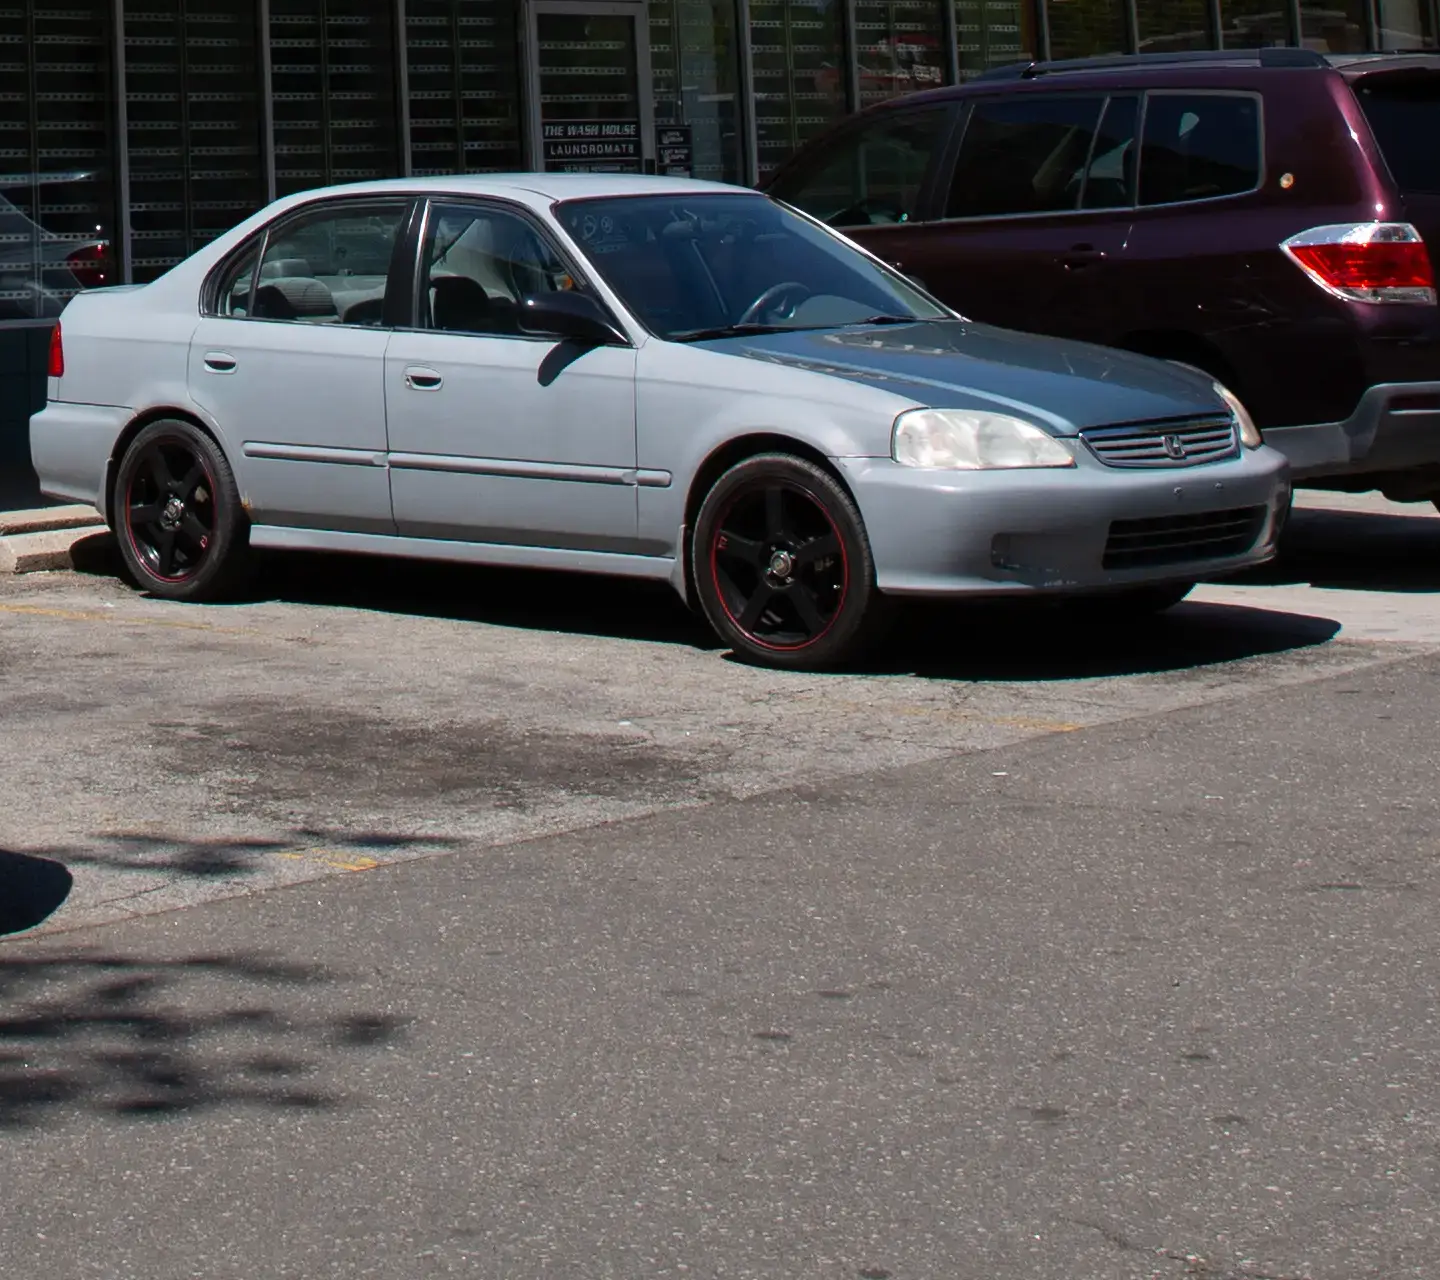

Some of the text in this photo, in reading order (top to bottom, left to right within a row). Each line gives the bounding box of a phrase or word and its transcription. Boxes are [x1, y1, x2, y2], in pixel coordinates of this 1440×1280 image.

[544, 124, 636, 136] THE WASH HOUSE
